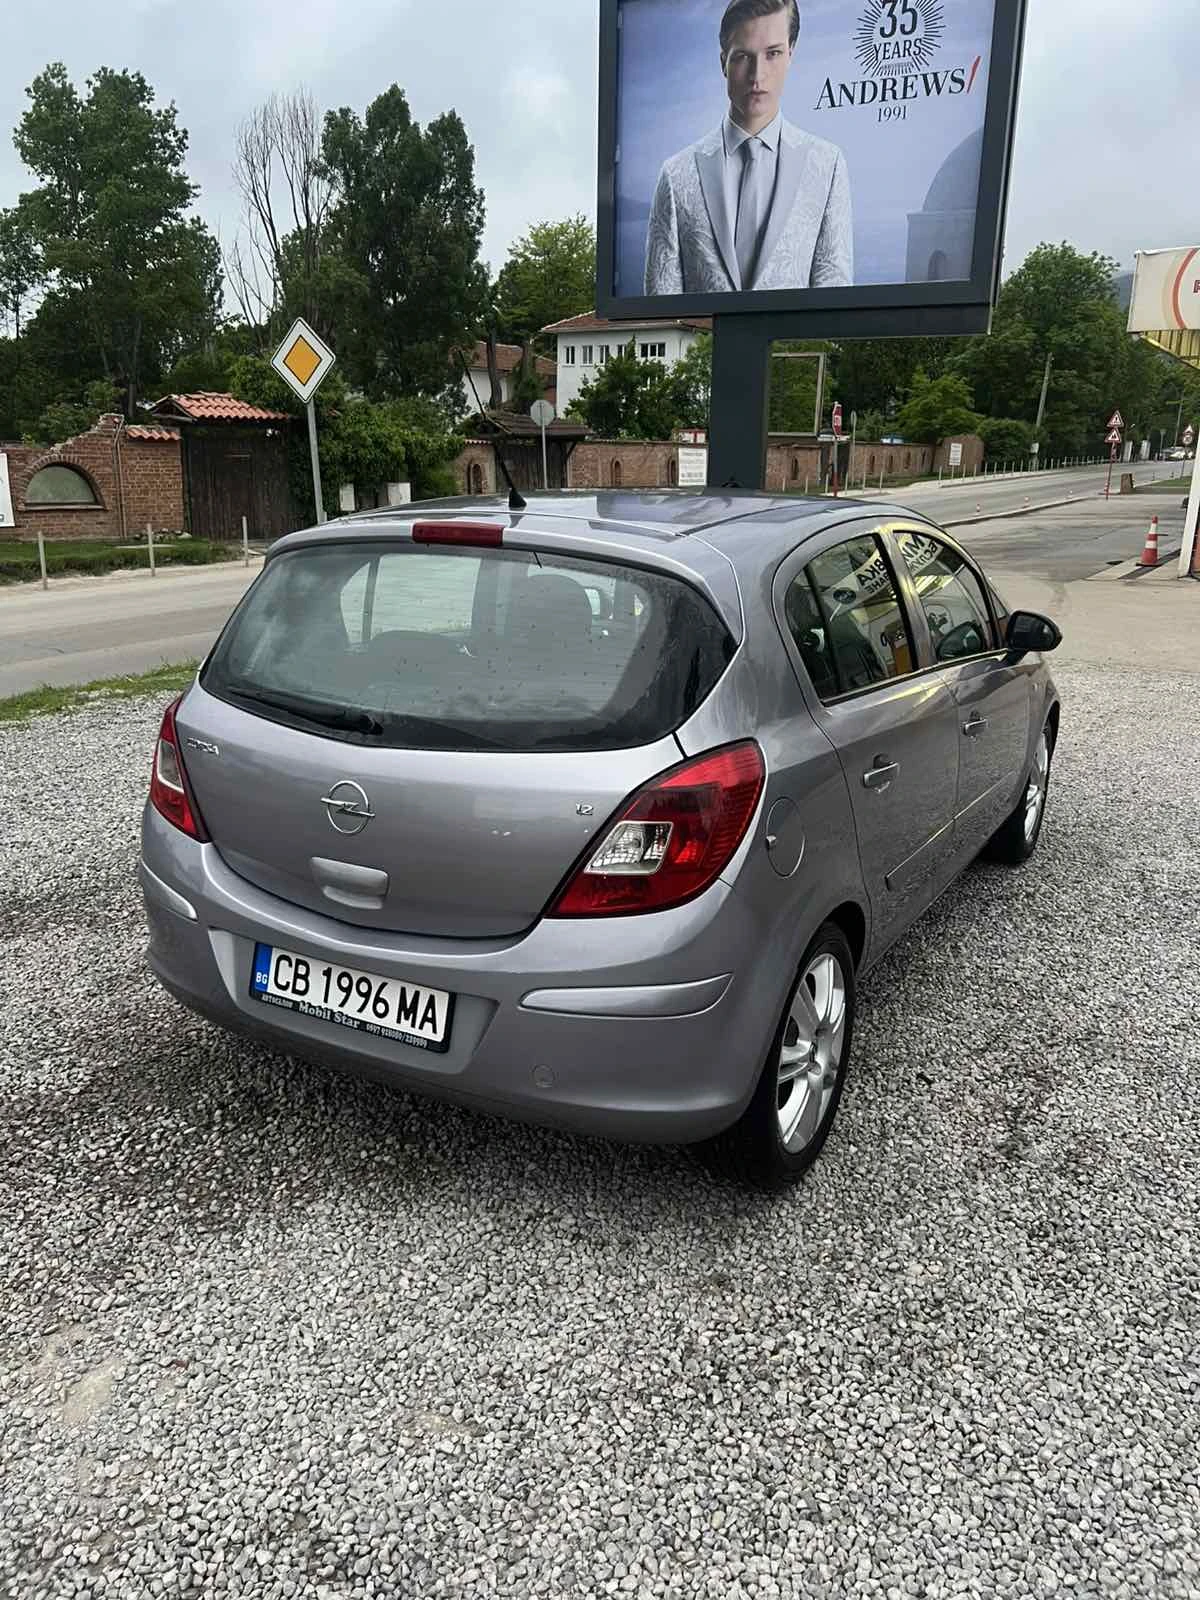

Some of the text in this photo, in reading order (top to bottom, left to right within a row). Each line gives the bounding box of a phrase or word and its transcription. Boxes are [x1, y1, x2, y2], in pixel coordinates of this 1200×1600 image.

[880, 0, 918, 38] 35
[873, 38, 923, 61] YEARS
[878, 105, 907, 122] 1991
[256, 971, 269, 985] BG
[273, 954, 438, 1035] CB 1996 MA
[299, 1002, 331, 1020] Mobil
[334, 1012, 360, 1028] Star
